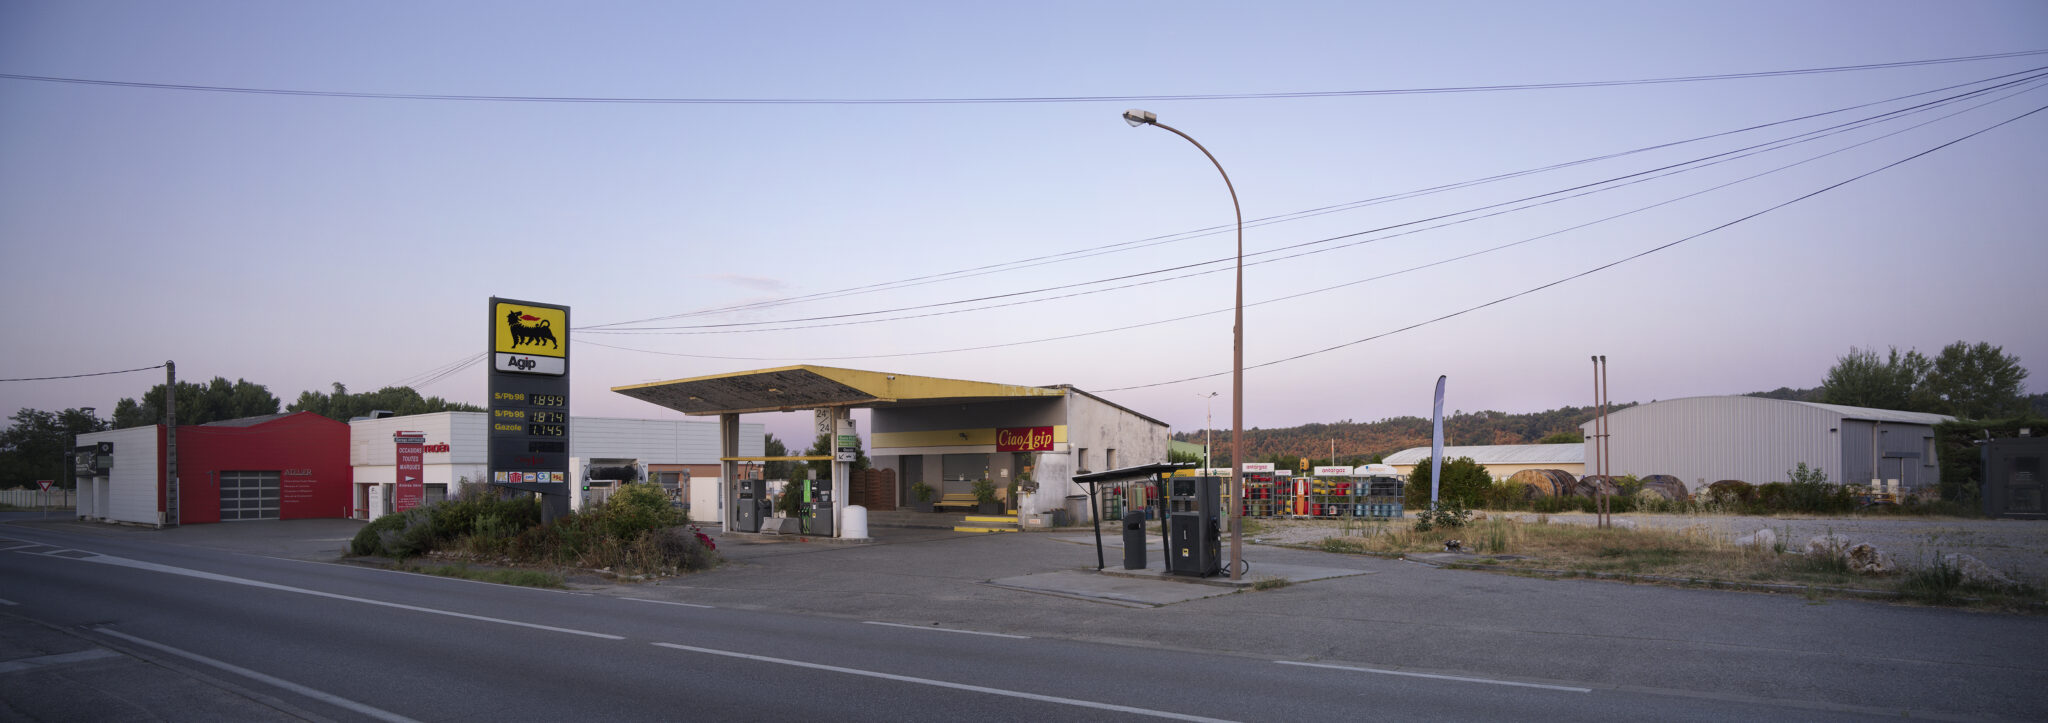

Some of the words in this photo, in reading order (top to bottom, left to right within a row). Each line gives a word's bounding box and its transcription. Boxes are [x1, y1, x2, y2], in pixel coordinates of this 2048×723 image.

[508, 355, 536, 370] Agip
[494, 423, 522, 431] Gazole
[820, 424, 830, 432] 24
